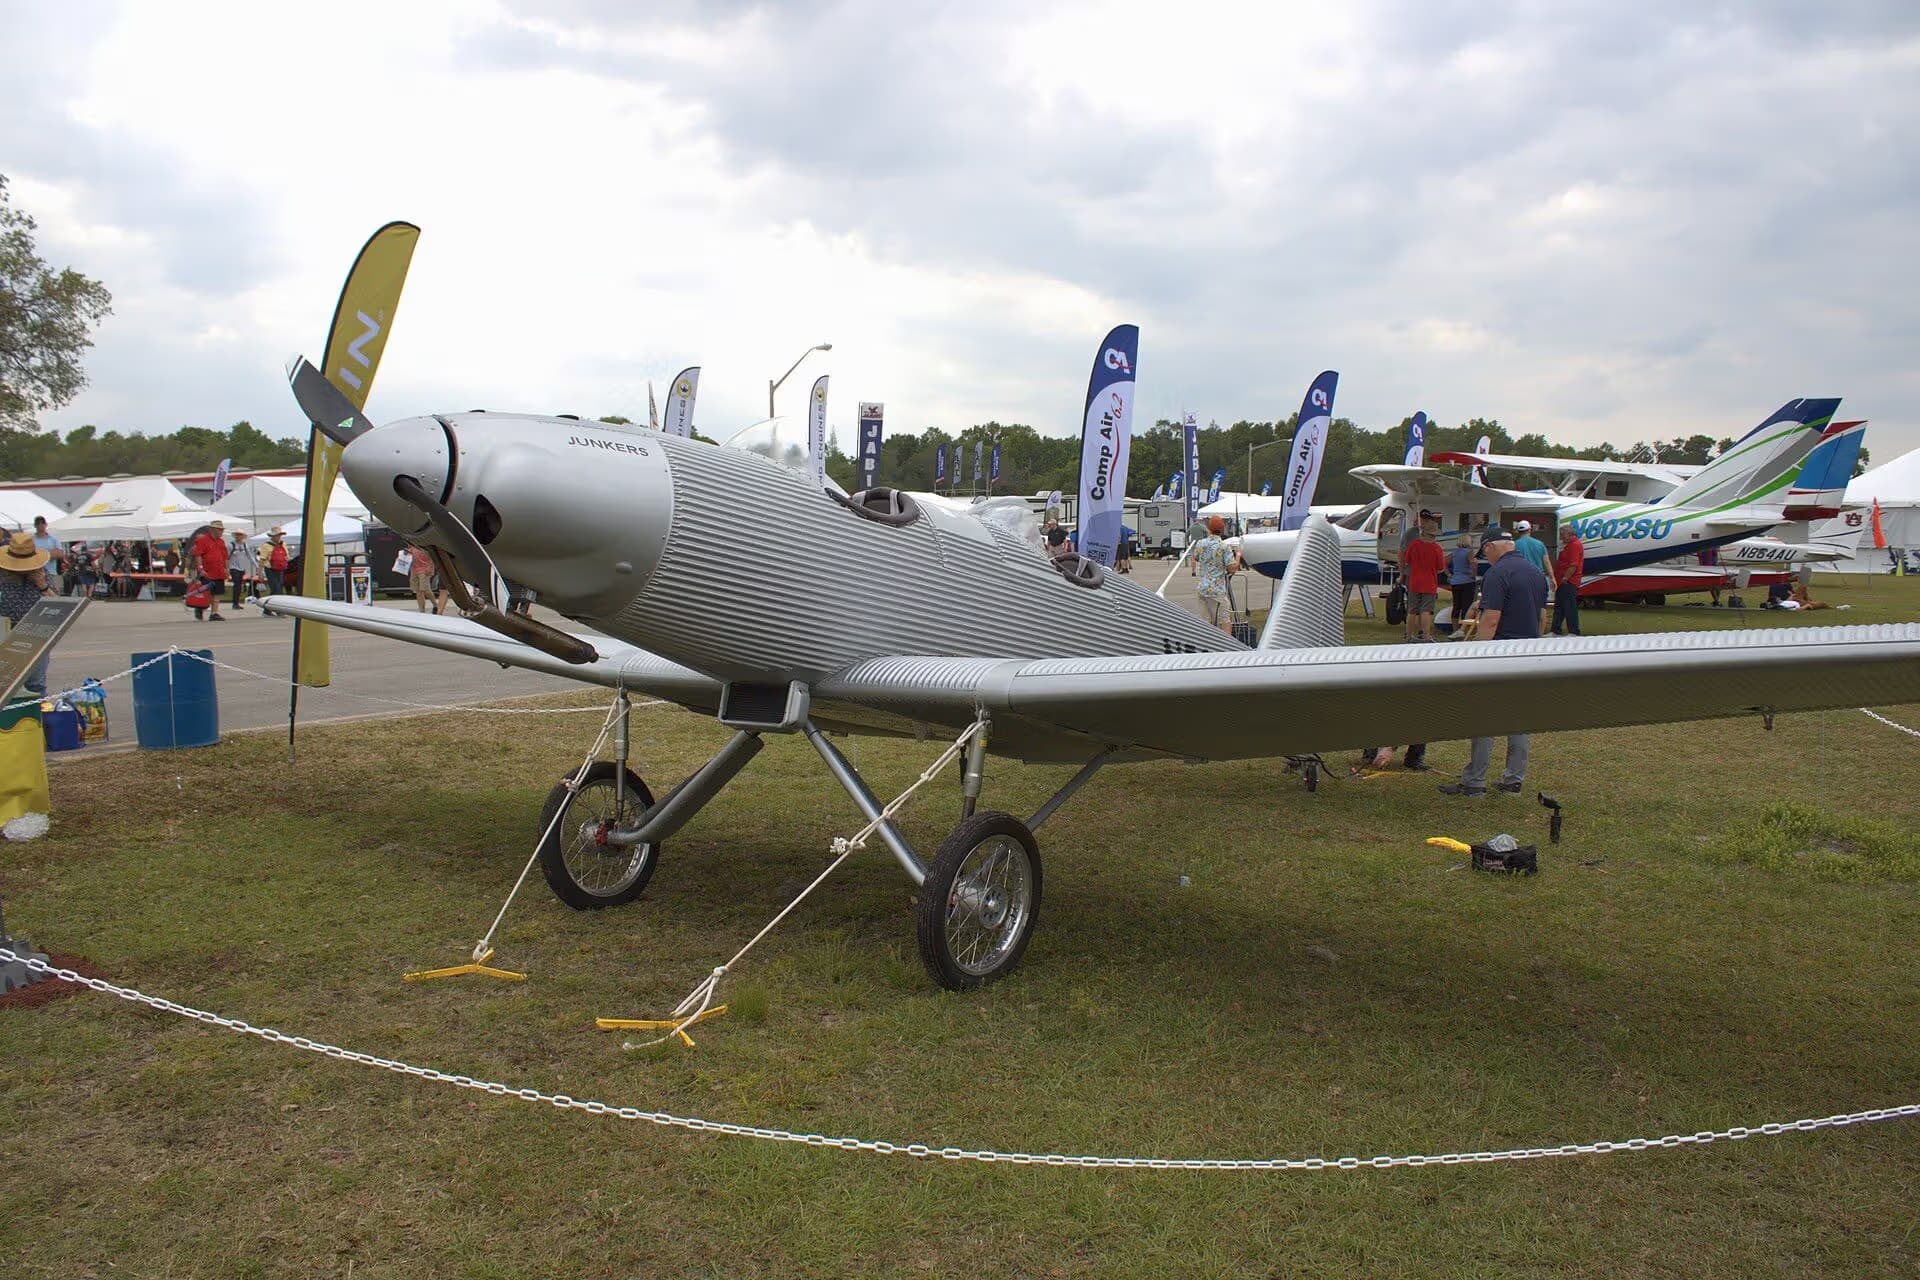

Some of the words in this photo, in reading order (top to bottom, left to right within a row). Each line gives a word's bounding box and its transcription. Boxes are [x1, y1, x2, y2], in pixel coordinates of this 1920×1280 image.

[677, 399, 686, 436] INES
[1100, 411, 1114, 441] Air
[568, 436, 649, 457] JUNKERS
[1091, 446, 1113, 501] Comp
[1191, 429, 1200, 512] JABIRU
[1286, 465, 1307, 508] Comp
[1300, 438, 1312, 461] Air
